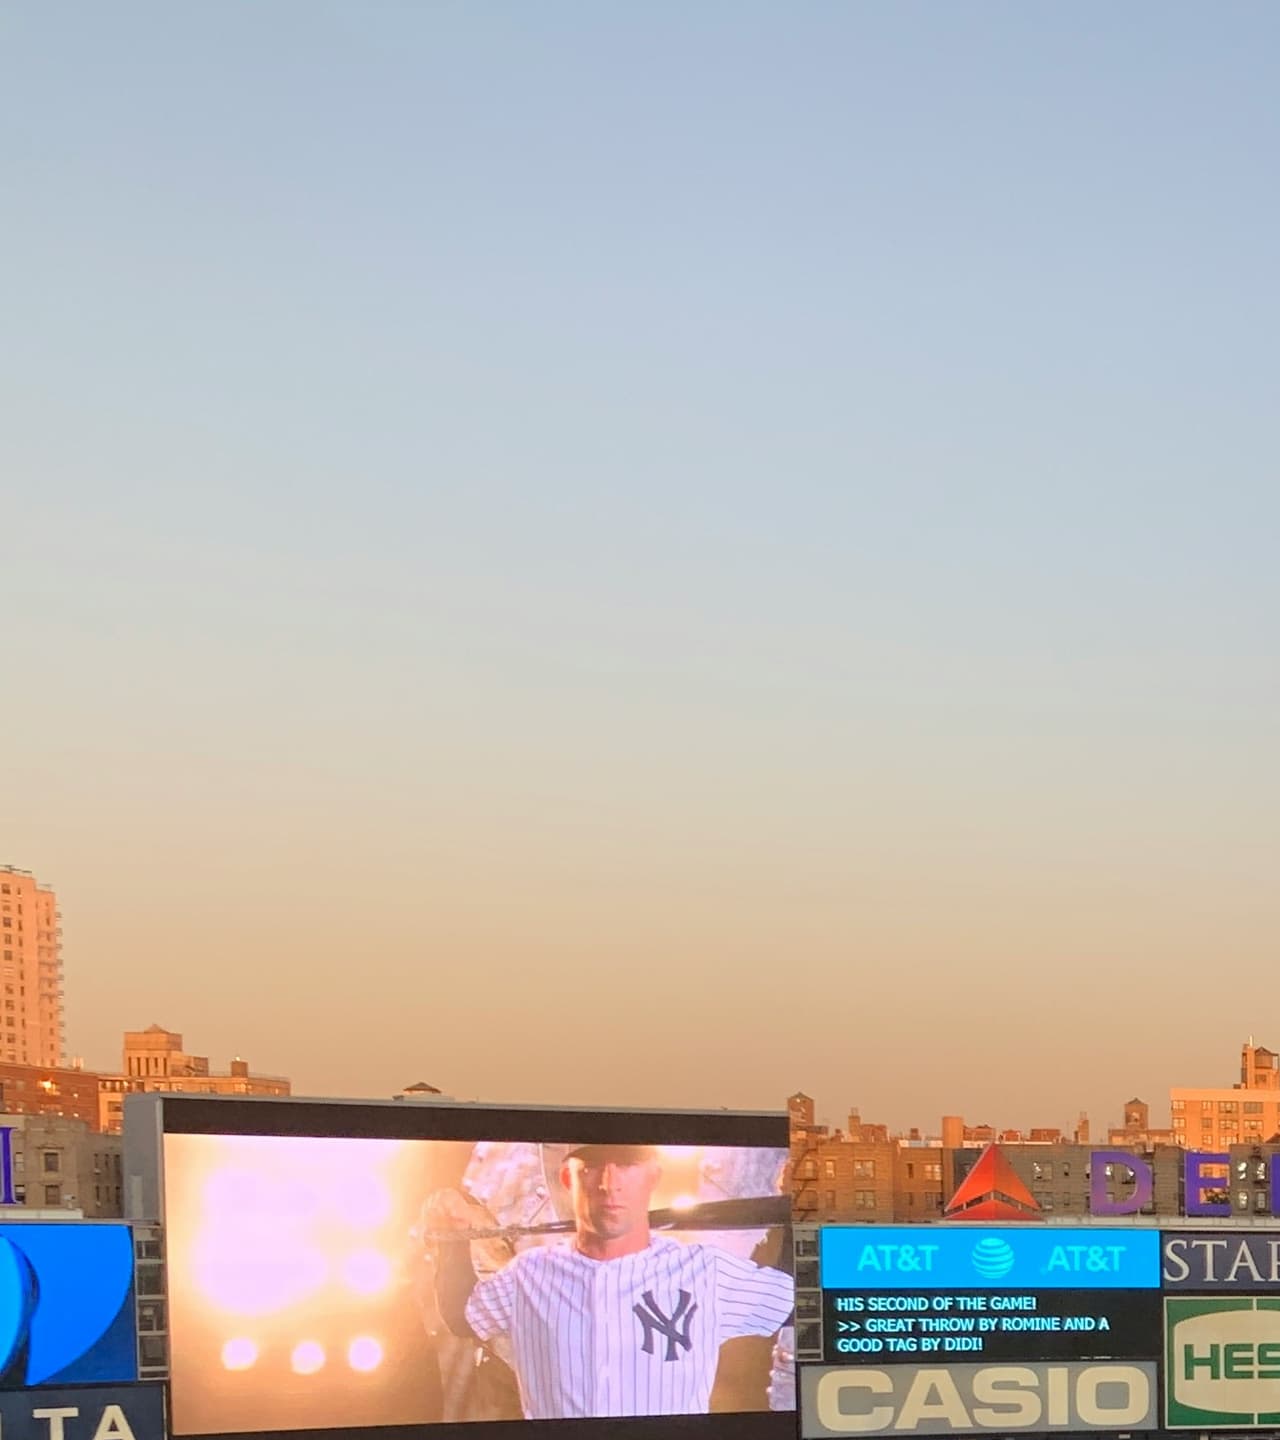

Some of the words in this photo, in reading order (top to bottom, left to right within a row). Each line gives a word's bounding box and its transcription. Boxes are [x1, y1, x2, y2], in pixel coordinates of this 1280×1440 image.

[857, 1245, 938, 1272] AT&T
[1047, 1245, 1127, 1272] AT&T
[837, 1297, 865, 1312] HIS
[868, 1296, 930, 1311] SECOND
[933, 1296, 953, 1311] OF
[956, 1296, 987, 1311] THE
[990, 1296, 1036, 1310] GAME!
[866, 1318, 914, 1333] GREAT
[919, 1318, 975, 1332] THROW
[979, 1318, 999, 1331] BY
[1002, 1317, 1060, 1332] ROMINE
[1065, 1317, 1096, 1331] AND
[1098, 1317, 1110, 1331] A
[837, 1338, 883, 1352] GOOD
[885, 1338, 918, 1352] TAG
[921, 1338, 939, 1351] BY
[945, 1337, 983, 1351] DIDI!
[816, 1365, 1150, 1432] CASIO
